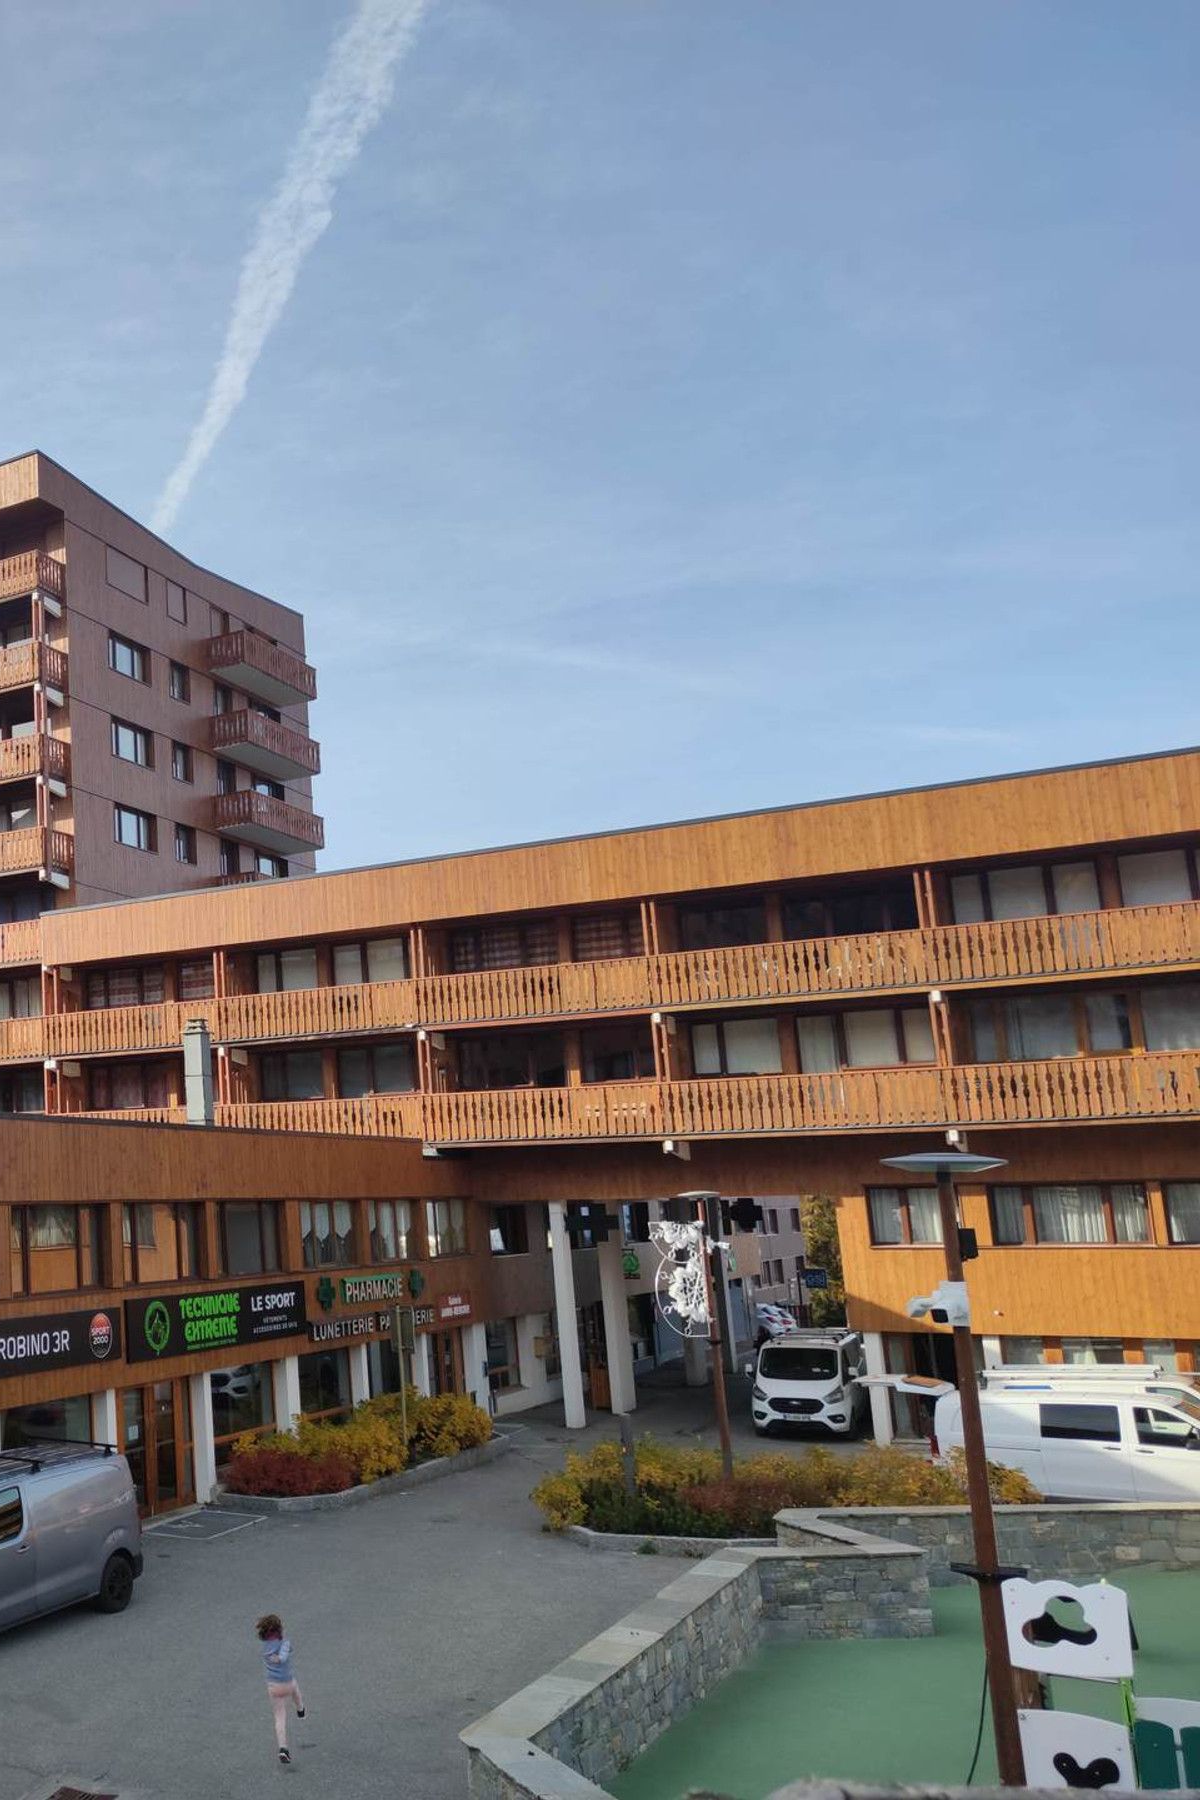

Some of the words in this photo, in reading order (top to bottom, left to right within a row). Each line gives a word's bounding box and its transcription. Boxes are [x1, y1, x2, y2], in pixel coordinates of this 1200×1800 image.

[251, 1295, 263, 1312] LE
[265, 1291, 296, 1310] SPORT
[346, 1278, 403, 1303] PHARMACIE
[179, 1292, 241, 1319] TECHNIQUE
[90, 1325, 110, 1336] SPORT
[92, 1335, 109, 1345] 2000
[313, 1316, 374, 1342] LUNETTERIE
[52, 1330, 70, 1353] 3R
